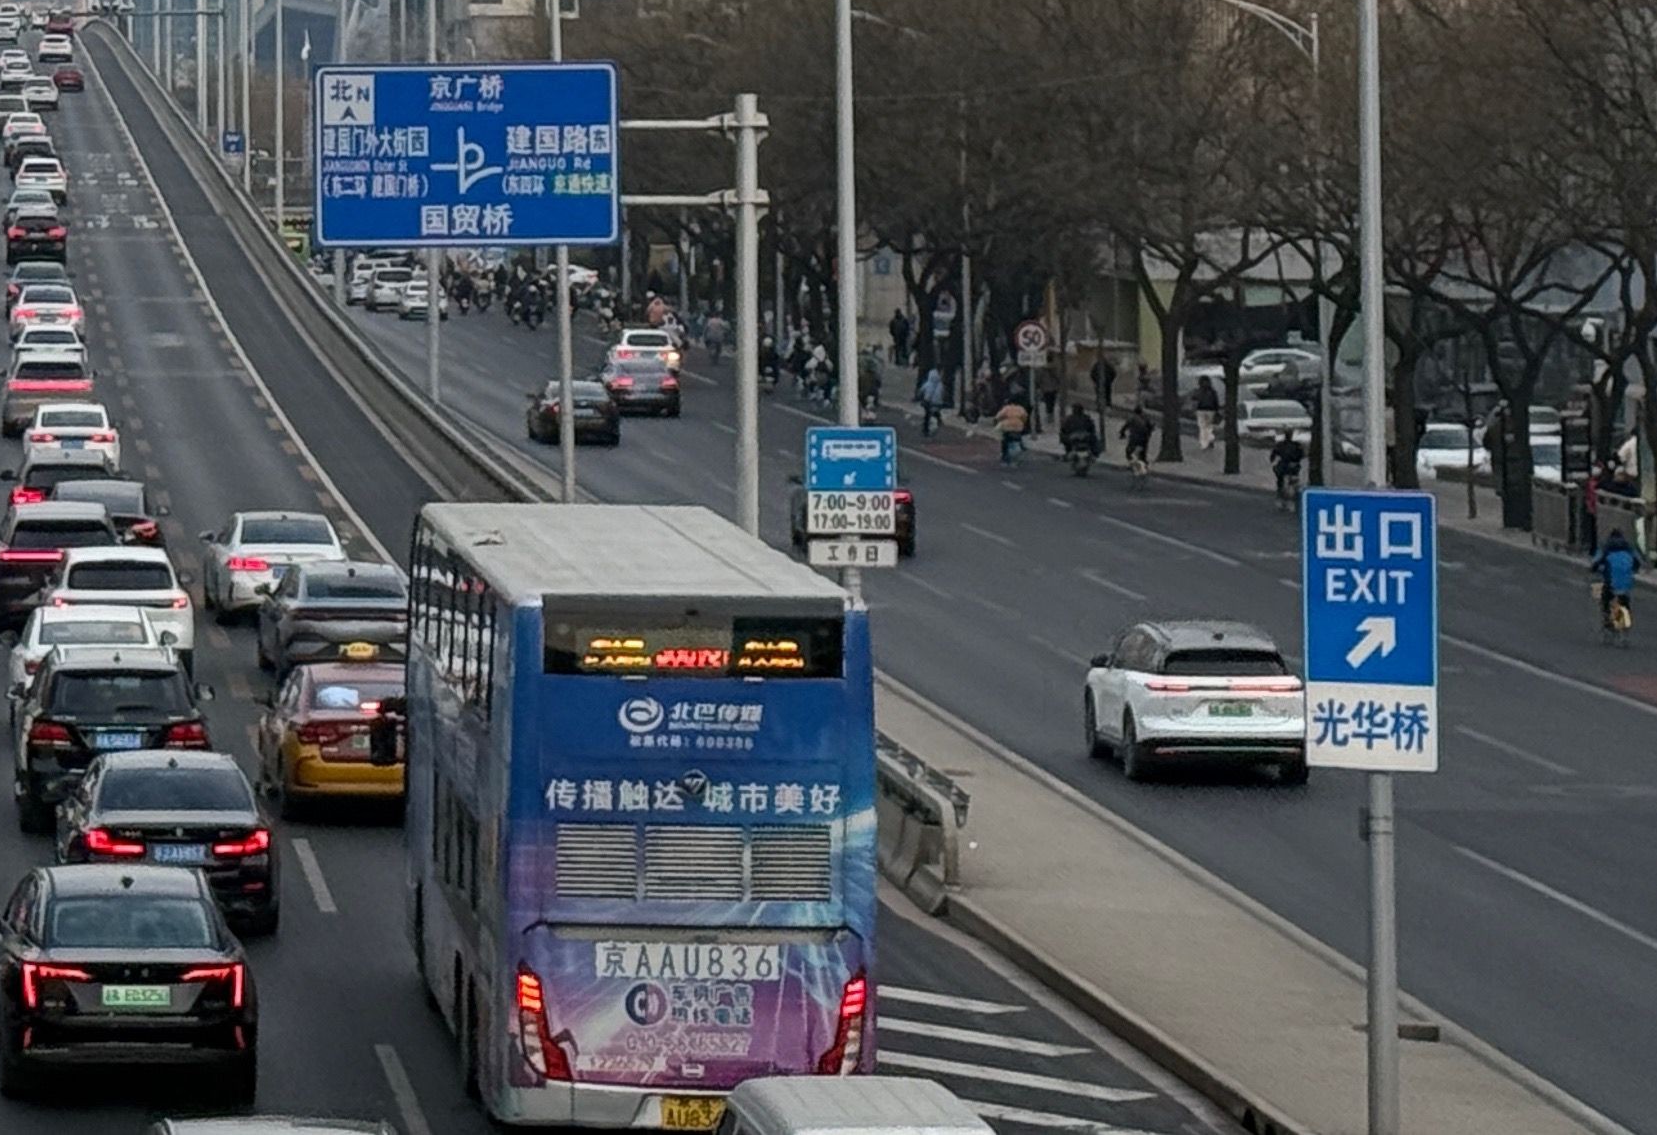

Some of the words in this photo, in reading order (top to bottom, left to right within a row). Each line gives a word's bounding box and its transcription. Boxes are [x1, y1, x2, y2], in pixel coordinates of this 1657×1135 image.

[330, 79, 353, 102] 北
[357, 86, 370, 102] N
[429, 74, 504, 99] 京广桥
[421, 203, 514, 236] 国贸桥
[1022, 329, 1041, 347] 50
[1316, 504, 1422, 561] 出口
[1326, 569, 1414, 604] EXIT
[1312, 699, 1429, 753] 光华桥
[545, 778, 684, 811] 传播触达
[702, 780, 842, 815] 城市美好
[602, 944, 773, 981] 京AAU836
